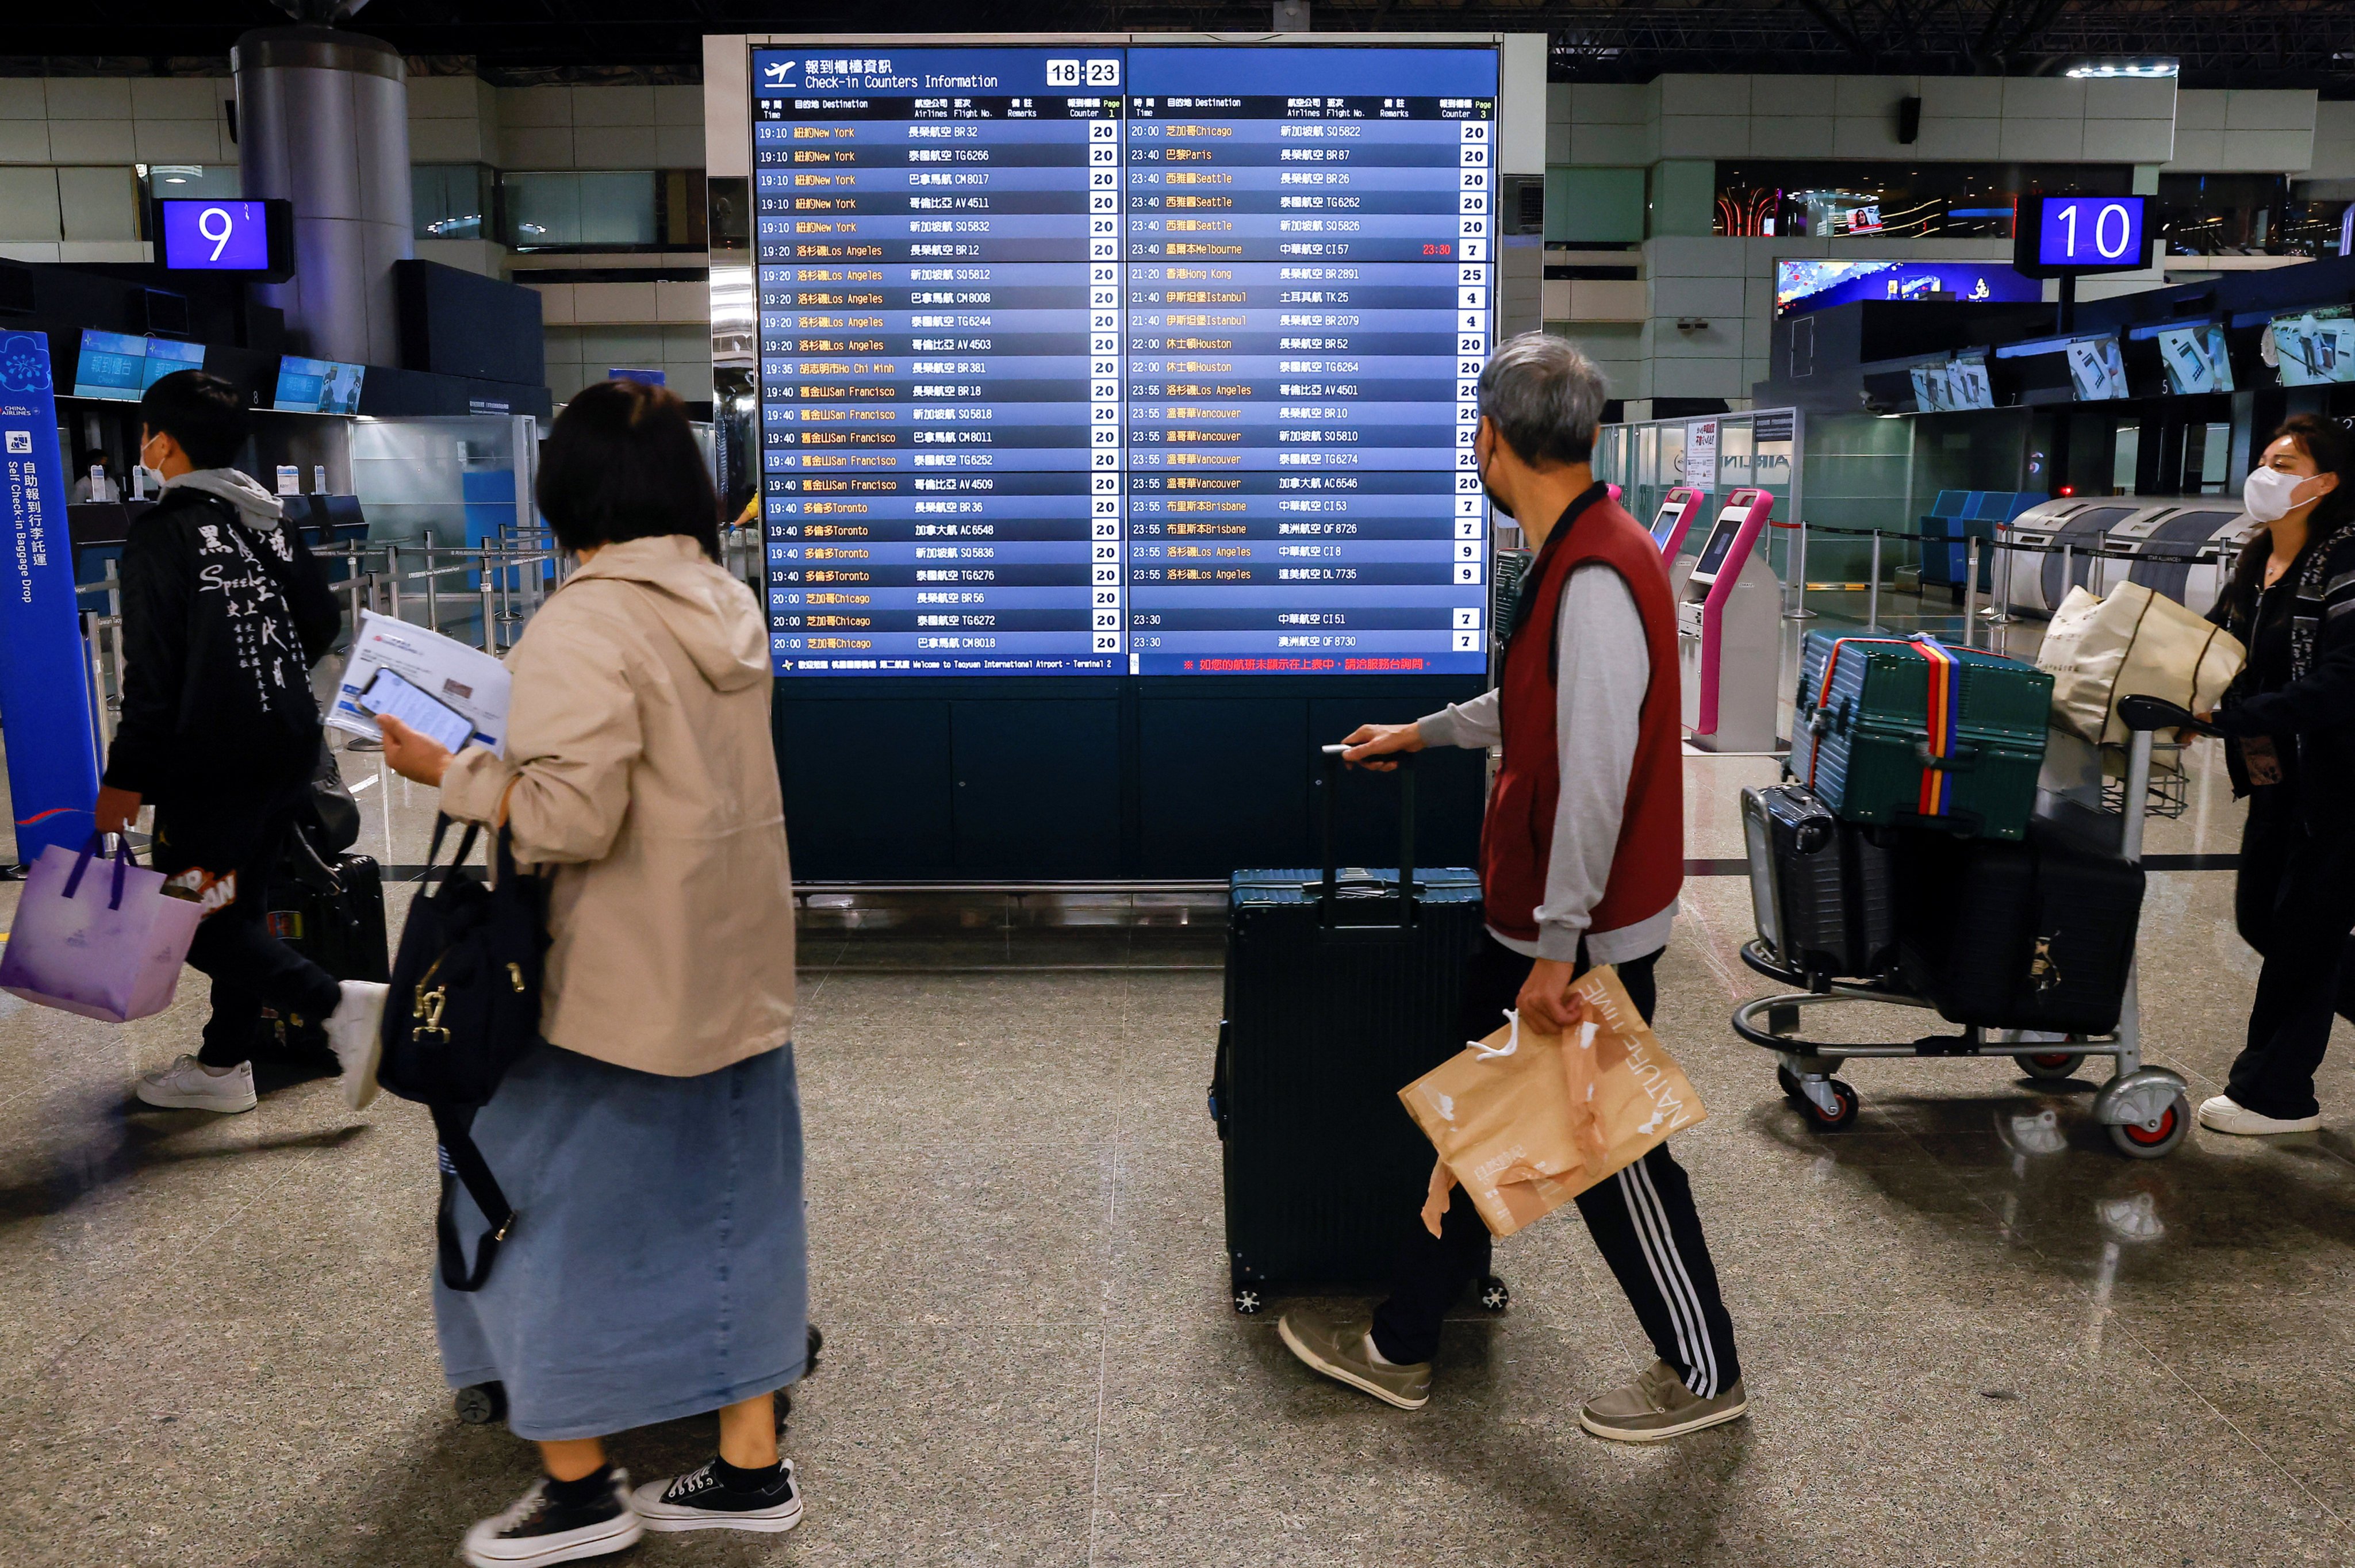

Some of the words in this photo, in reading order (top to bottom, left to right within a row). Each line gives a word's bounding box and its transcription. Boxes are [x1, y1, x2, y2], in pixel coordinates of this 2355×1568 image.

[806, 75, 858, 89] Check-in
[865, 75, 918, 88] Counters
[925, 75, 998, 87] Information
[795, 99, 819, 109] 目的地
[823, 99, 868, 109] Destination
[915, 99, 948, 108] 航空公司
[1103, 100, 1120, 108] Page
[1167, 98, 1192, 107] 目的地
[1195, 98, 1241, 107] Destination
[1287, 98, 1321, 108] 航空公司
[1475, 101, 1491, 109] Page
[764, 110, 781, 118] Time
[915, 109, 948, 117] Airlines
[954, 109, 978, 118] Flight
[981, 109, 992, 117] No.
[1008, 109, 1037, 117] Remarks
[1109, 109, 1114, 117] 1
[1136, 109, 1153, 117] Time
[1287, 109, 1320, 117] Airlines
[1326, 109, 1351, 118] Flight
[1380, 109, 1409, 117] Remarks
[1442, 110, 1471, 118] Counter
[1480, 110, 1486, 118] 3
[760, 128, 787, 139] 19:10
[834, 127, 854, 137] York
[908, 126, 952, 137] 長榮航空
[1094, 126, 1113, 137] 20
[1132, 126, 1159, 136] 20:00
[1280, 125, 1324, 137] 新加坡航
[1465, 127, 1484, 138] 20
[1132, 149, 1159, 160] 23:40
[1280, 149, 1324, 160] 長榮航空
[1464, 151, 1483, 162] 20
[198, 208, 232, 261] 9
[2058, 204, 2130, 258] 10
[1132, 244, 1160, 254] 23:40
[1280, 243, 1323, 255] 中華航空
[1423, 244, 1450, 255] 23:30
[1468, 245, 1476, 256] 7
[1132, 269, 1160, 279] 21:20
[1211, 269, 1232, 280] Kong
[1279, 267, 1323, 279] 長榮航空
[1463, 270, 1481, 281] 25
[764, 294, 791, 304] 19:20
[847, 293, 883, 305] Angeles
[911, 292, 954, 304] 巴拿馬航
[1095, 293, 1113, 303] 20
[1132, 292, 1160, 302] 21:40
[1279, 291, 1323, 303] 土耳其航
[1467, 293, 1476, 304] 4
[766, 363, 793, 374] 19:35
[854, 363, 868, 373] Chi
[873, 363, 894, 373] Minh
[912, 362, 955, 374] 長榮航空
[1095, 363, 1114, 373] 20
[1132, 362, 1160, 373] 22:00
[1279, 361, 1322, 373] 泰國航空
[1462, 363, 1480, 373] 20
[2162, 379, 2168, 394] 5
[253, 390, 259, 404] 8
[8, 461, 20, 482] Self
[1133, 478, 1160, 489] 23:55
[1279, 477, 1322, 489] 加拿大航
[1459, 478, 1478, 489] 20
[11, 484, 23, 530] Check-in
[771, 526, 797, 536] 19:40
[915, 524, 958, 536] 加拿大航
[1096, 525, 1115, 535] 20
[16, 532, 29, 577] Baggage
[21, 579, 32, 603] Drop
[774, 639, 801, 649] 20:00
[918, 637, 960, 649] 巴拿馬航
[1097, 638, 1115, 648] 20
[1134, 637, 1161, 647] 23:30
[1278, 636, 1320, 647] 澳洲航空
[1462, 637, 1470, 646] 7
[954, 660, 981, 669] Taoyuan
[984, 660, 1033, 668] International
[1036, 660, 1063, 668] Airport
[1073, 660, 1103, 668] Terminal
[1107, 660, 1111, 668] 2
[1623, 1035, 1690, 1129] NATURE
